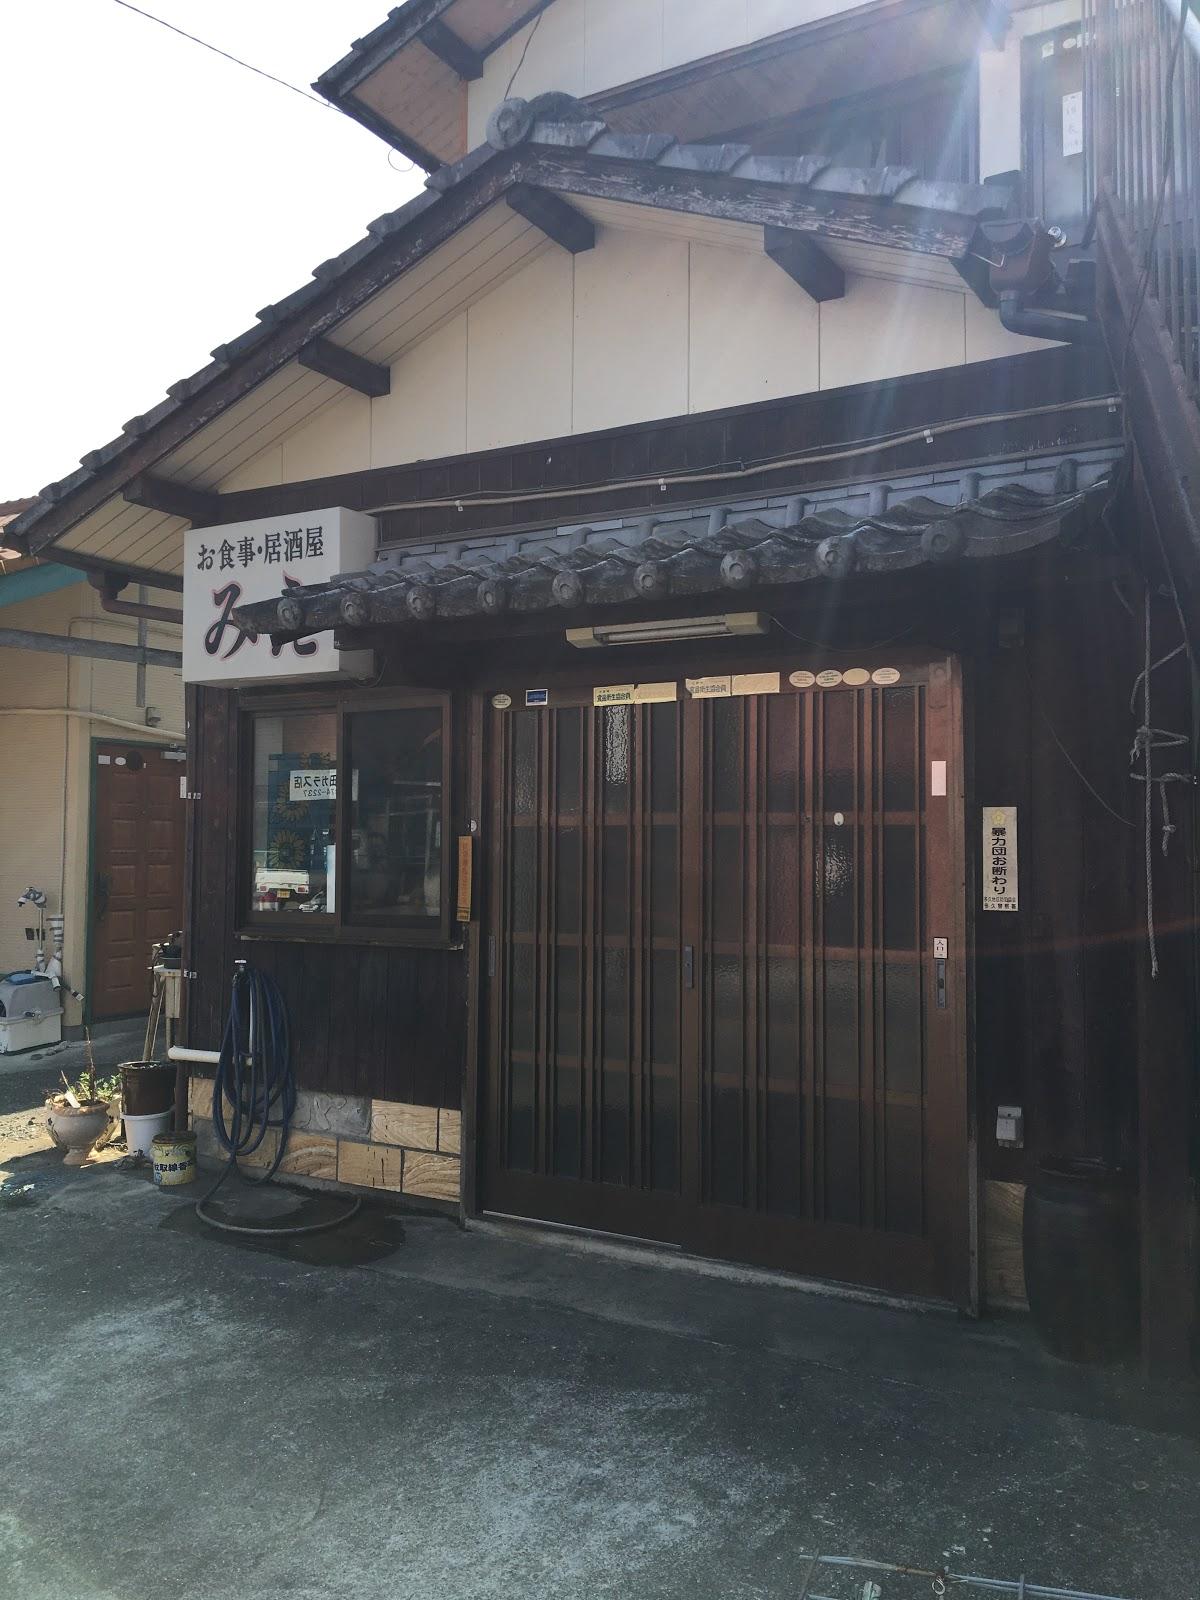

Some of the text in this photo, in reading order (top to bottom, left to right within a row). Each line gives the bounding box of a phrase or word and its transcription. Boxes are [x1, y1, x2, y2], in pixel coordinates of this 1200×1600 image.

[992, 827, 1007, 895] 暴力団お断わり
[936, 939, 944, 951] 入口
